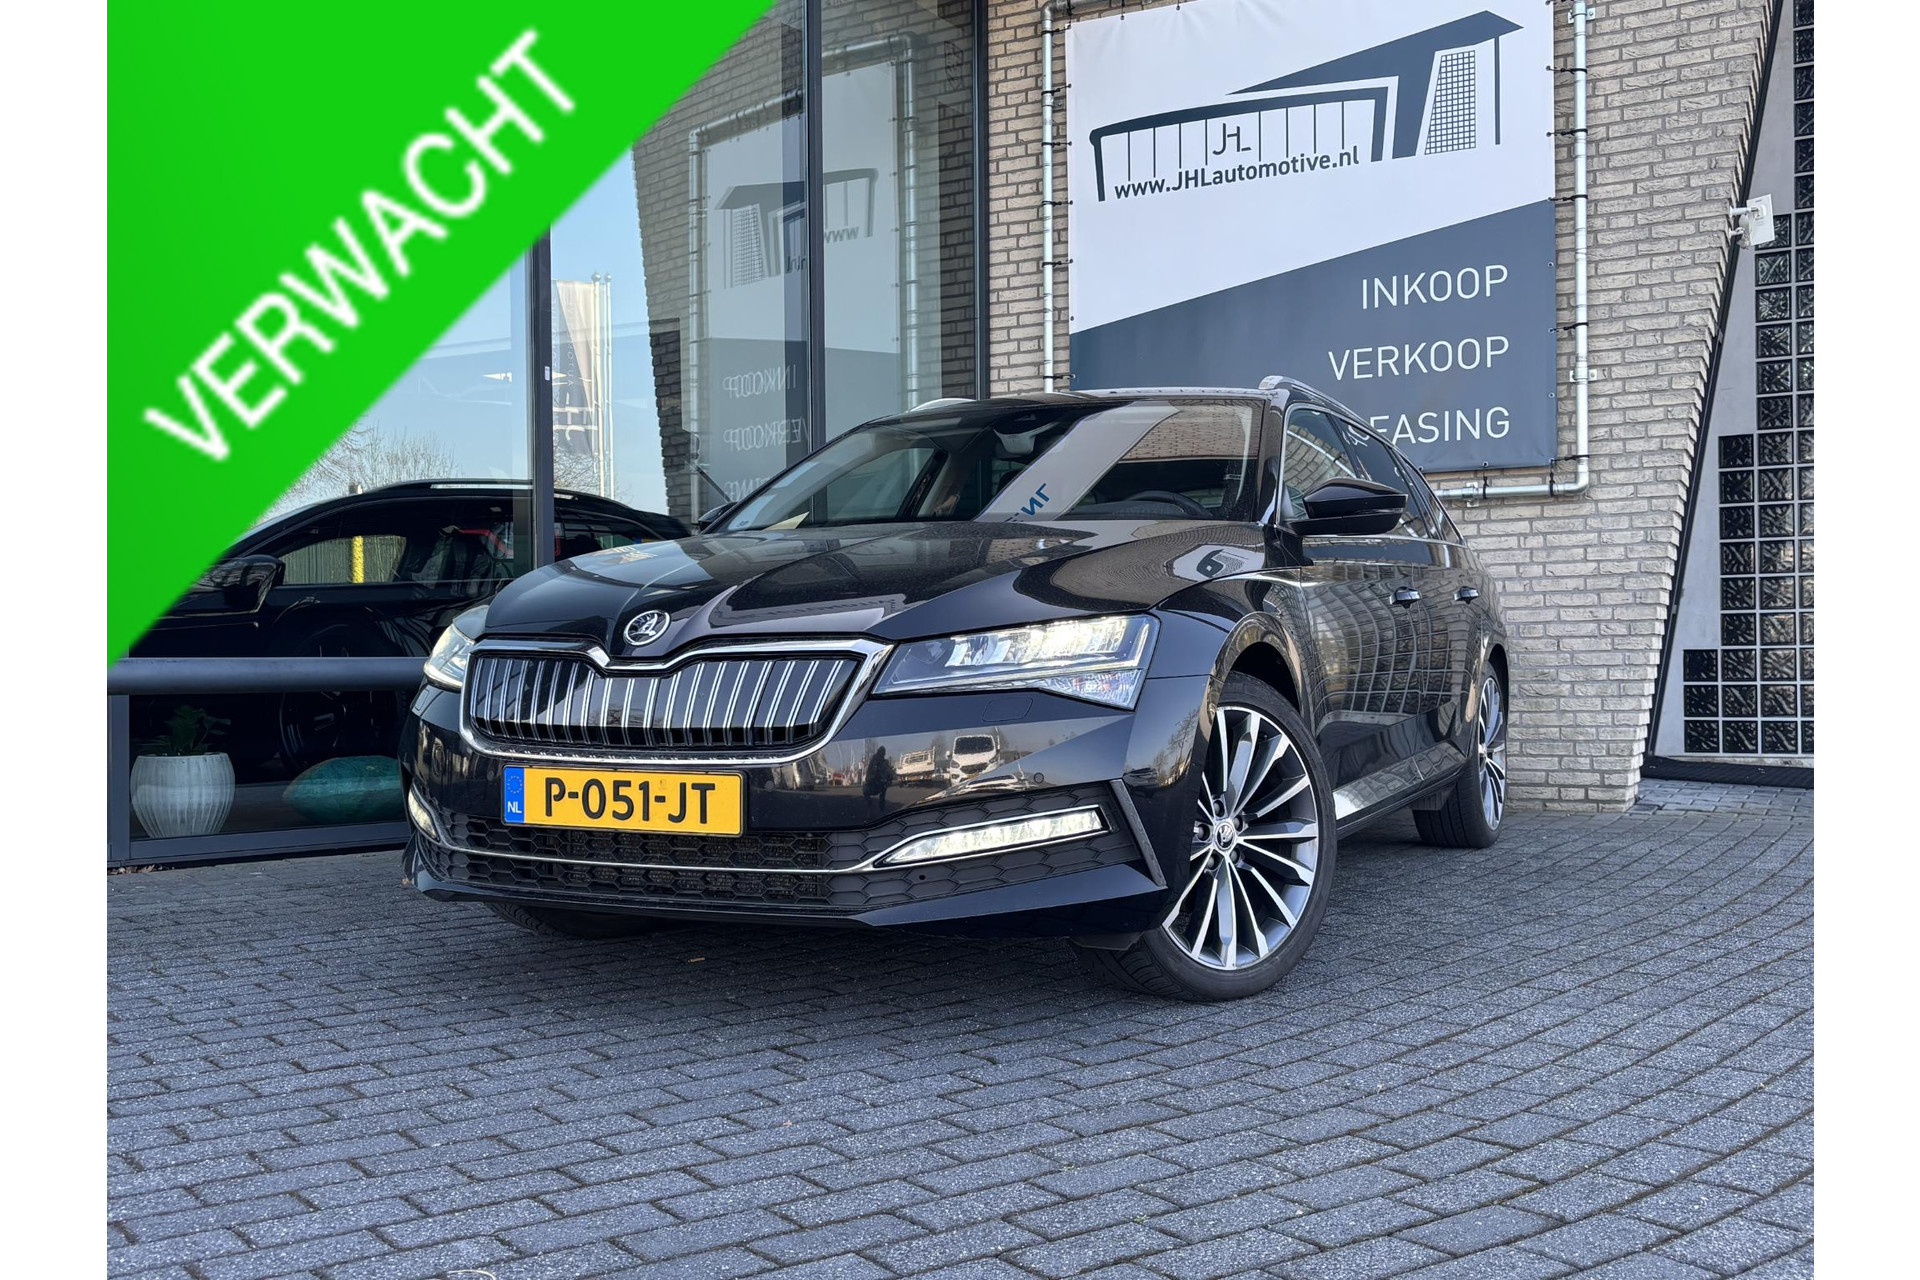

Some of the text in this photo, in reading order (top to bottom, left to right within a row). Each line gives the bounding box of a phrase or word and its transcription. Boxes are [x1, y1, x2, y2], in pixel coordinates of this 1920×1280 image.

[1114, 145, 1360, 200] www.JHLautomotive.nl
[1362, 264, 1508, 310] INKOOP
[1328, 335, 1509, 381] VERKOOP
[1369, 406, 1511, 445] EASING
[507, 803, 522, 814] NL
[545, 777, 716, 825] P-051-JT
